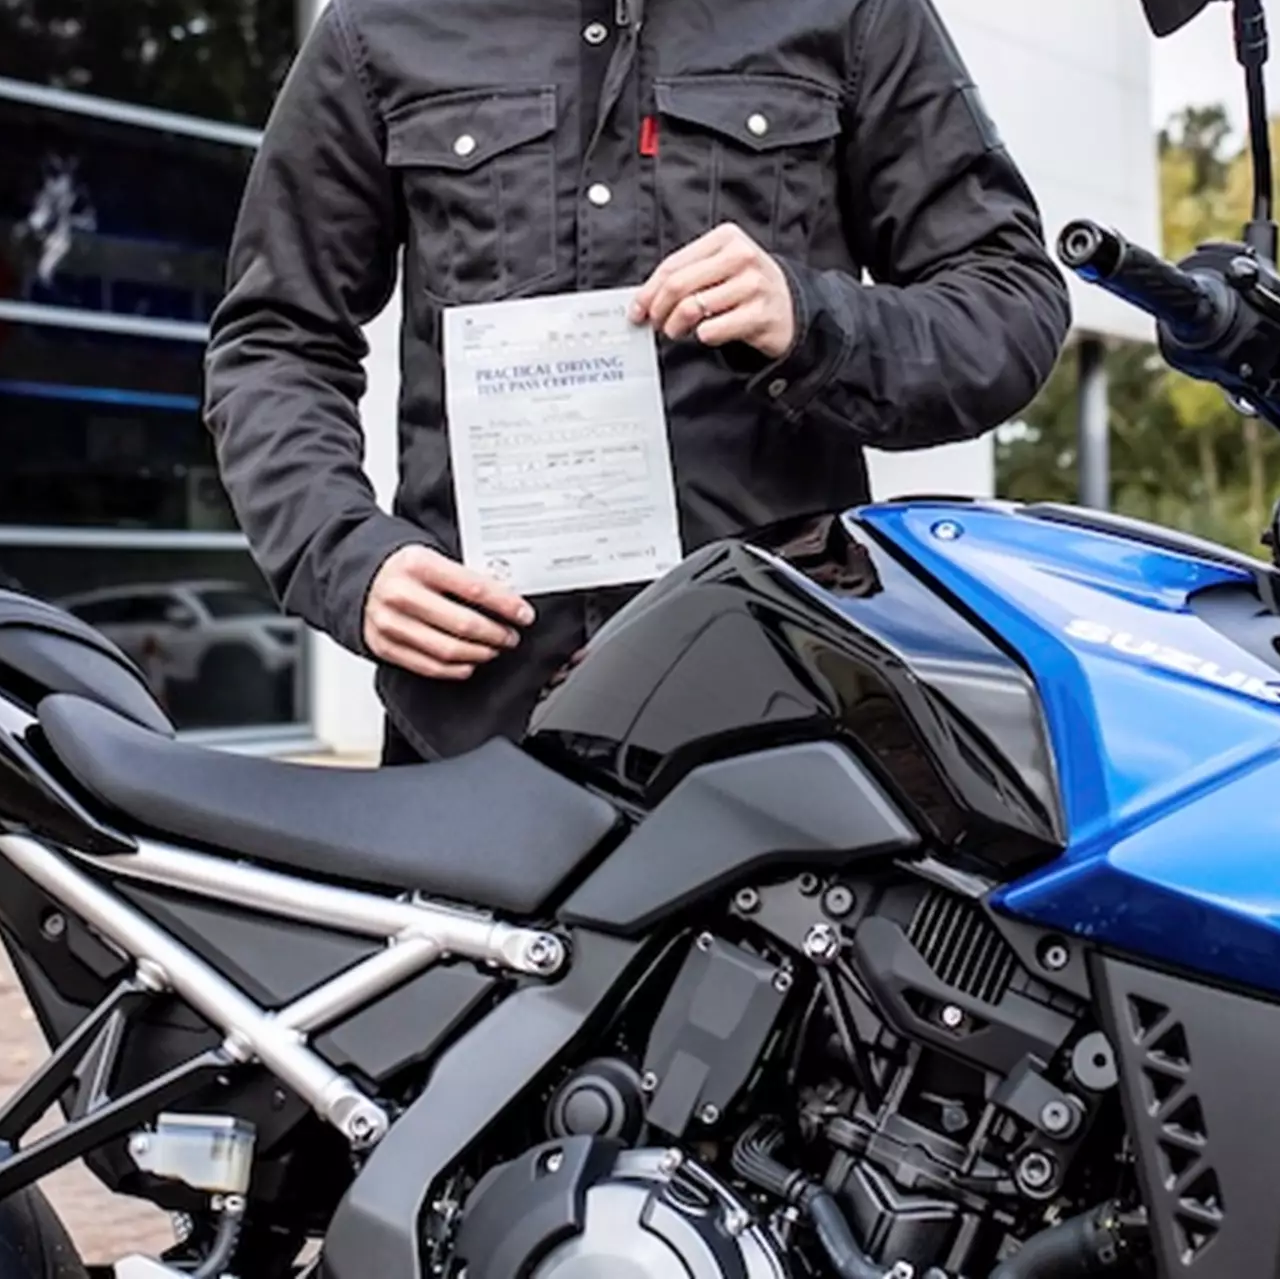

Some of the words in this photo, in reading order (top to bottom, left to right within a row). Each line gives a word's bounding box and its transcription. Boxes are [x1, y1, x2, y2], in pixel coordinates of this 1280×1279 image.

[476, 363, 552, 382] PRACTICAL
[557, 355, 623, 373] DRIVING
[477, 382, 507, 397] TEST
[509, 379, 540, 393] PASS
[543, 370, 624, 389] CERTIFICATE
